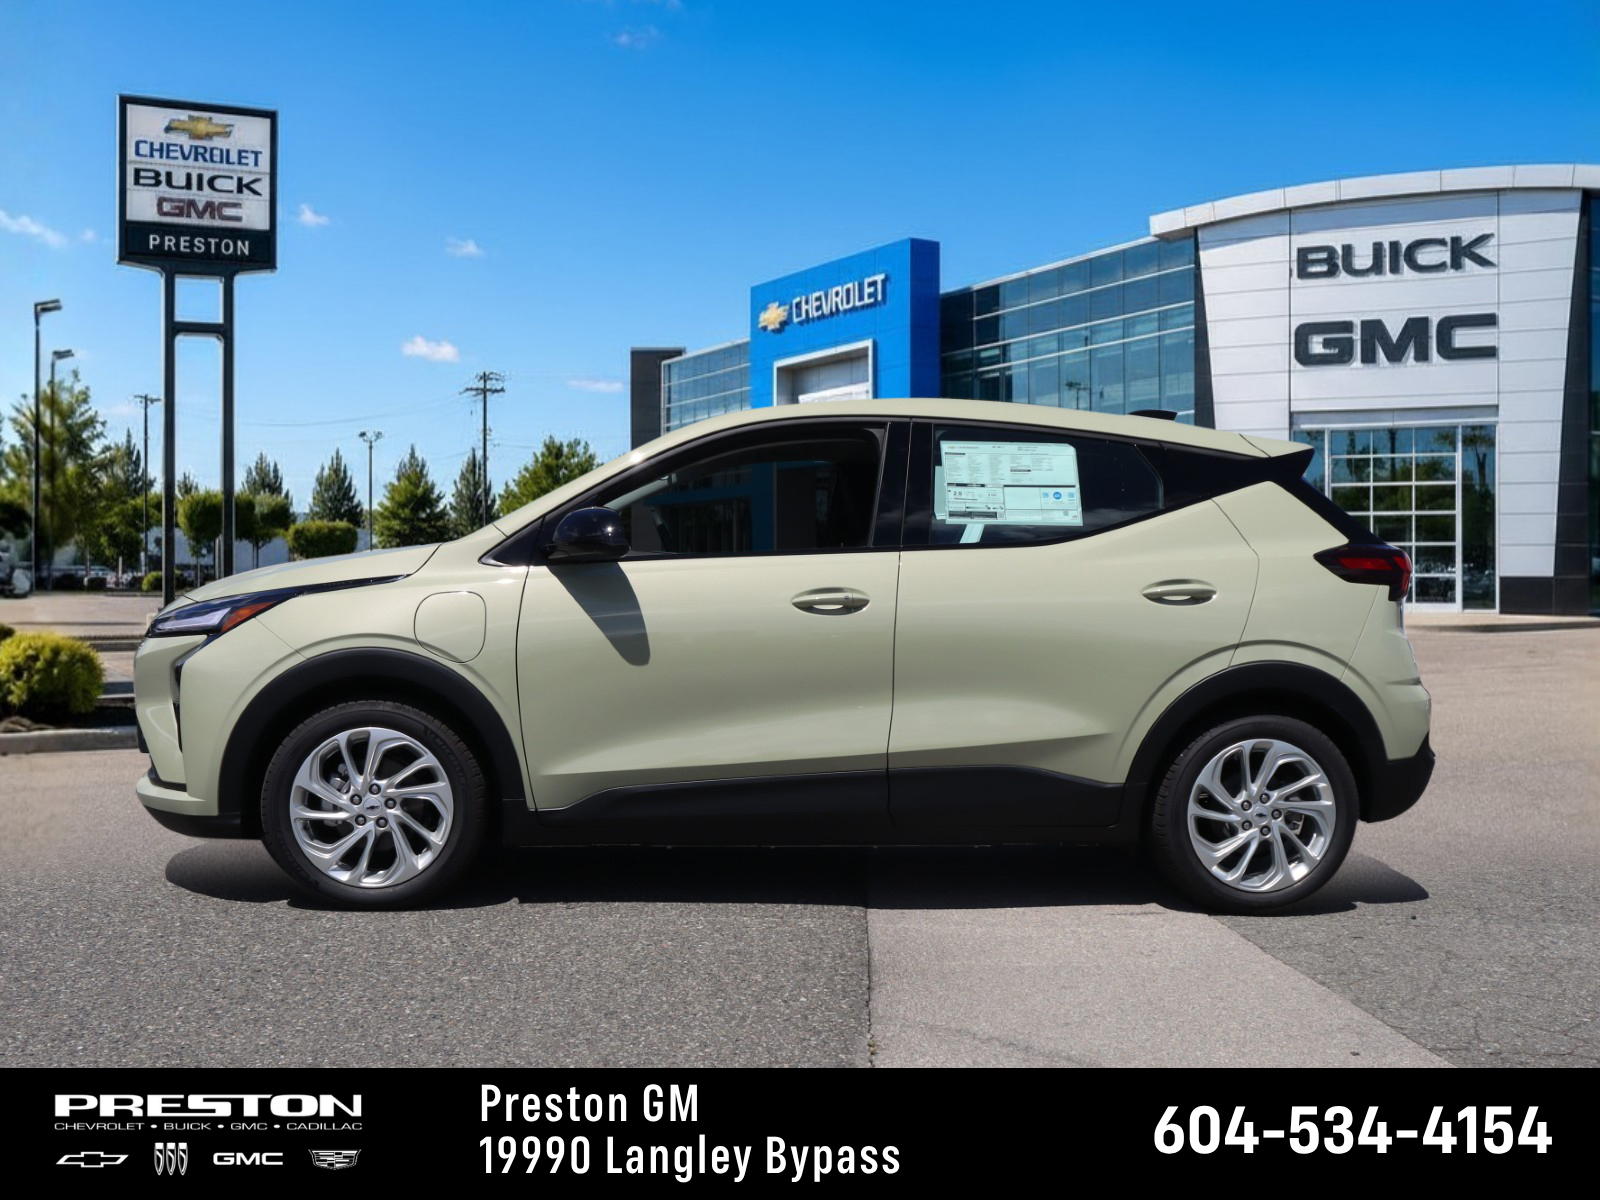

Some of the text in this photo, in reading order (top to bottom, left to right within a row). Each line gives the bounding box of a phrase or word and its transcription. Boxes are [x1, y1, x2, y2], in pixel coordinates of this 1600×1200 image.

[134, 140, 263, 167] CHEVROLET
[133, 168, 262, 196] BUICK
[156, 196, 243, 222] GMC
[149, 234, 250, 256] PRESTON
[1296, 233, 1498, 279] BUICK
[792, 273, 886, 323] CHEVROLET
[1294, 312, 1498, 366] GMC
